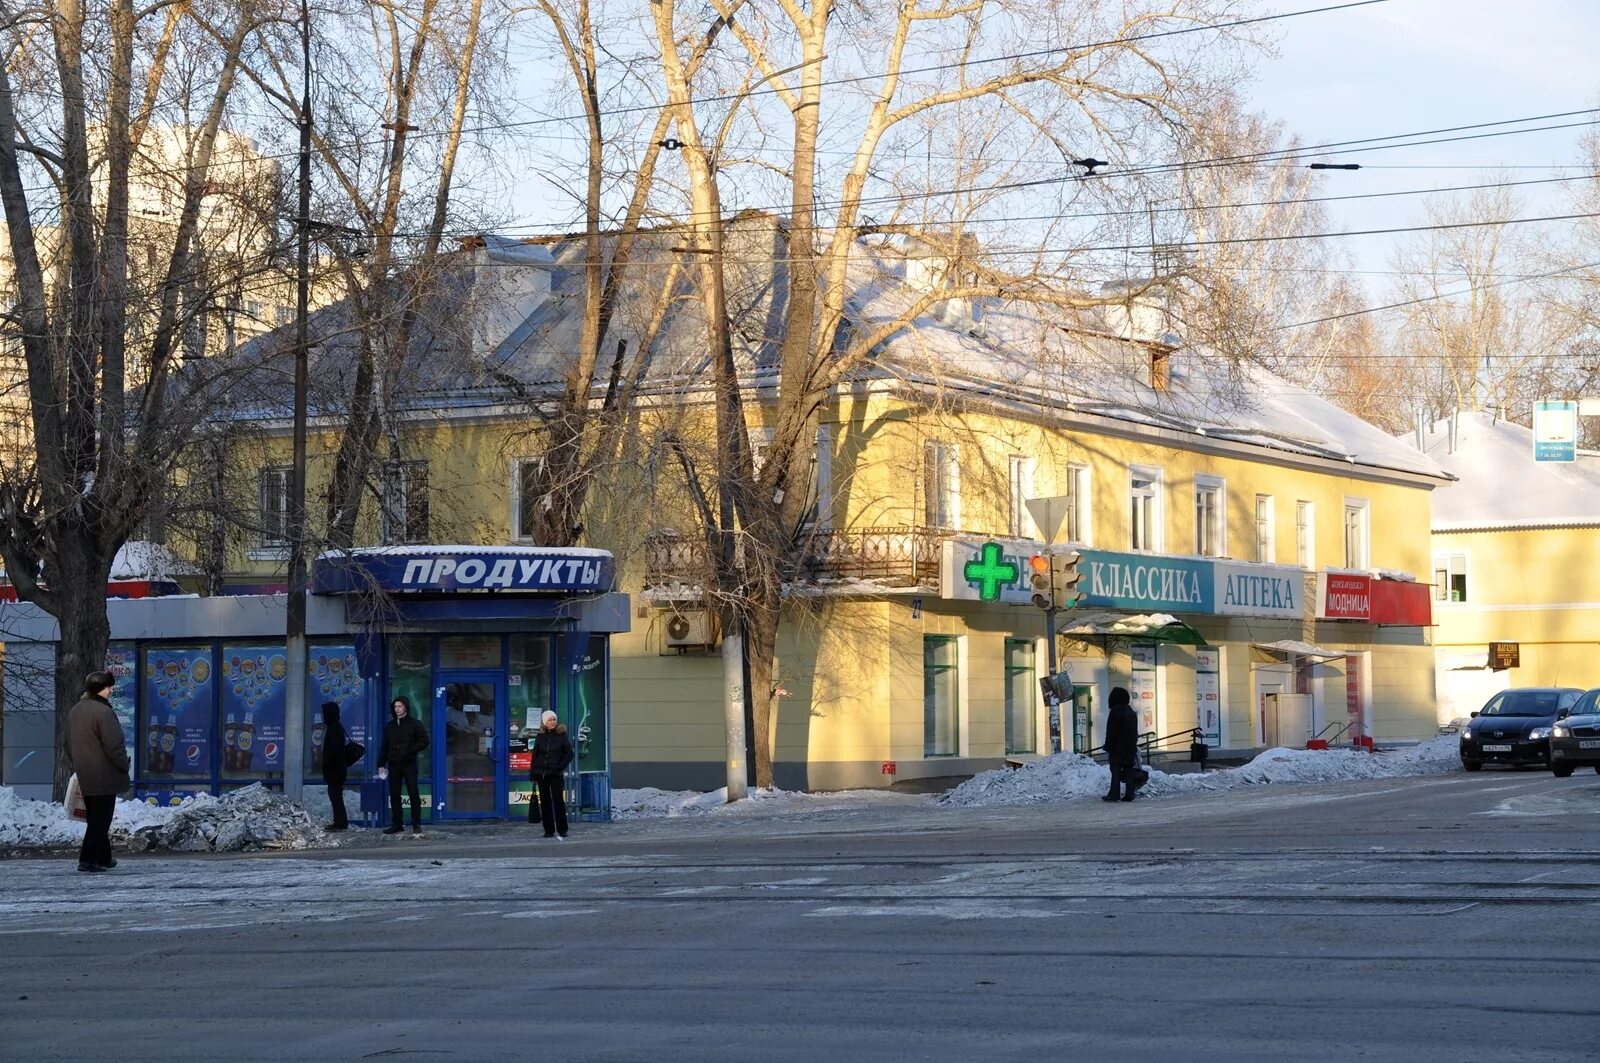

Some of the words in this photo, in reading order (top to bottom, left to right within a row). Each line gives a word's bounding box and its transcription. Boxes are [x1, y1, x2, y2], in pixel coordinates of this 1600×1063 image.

[401, 558, 601, 587] ПРОДУКТЫ
[1090, 561, 1202, 603] КЛАССИКА
[1224, 573, 1295, 609] АПТЕКА
[1328, 593, 1369, 614] МОДНИЦА
